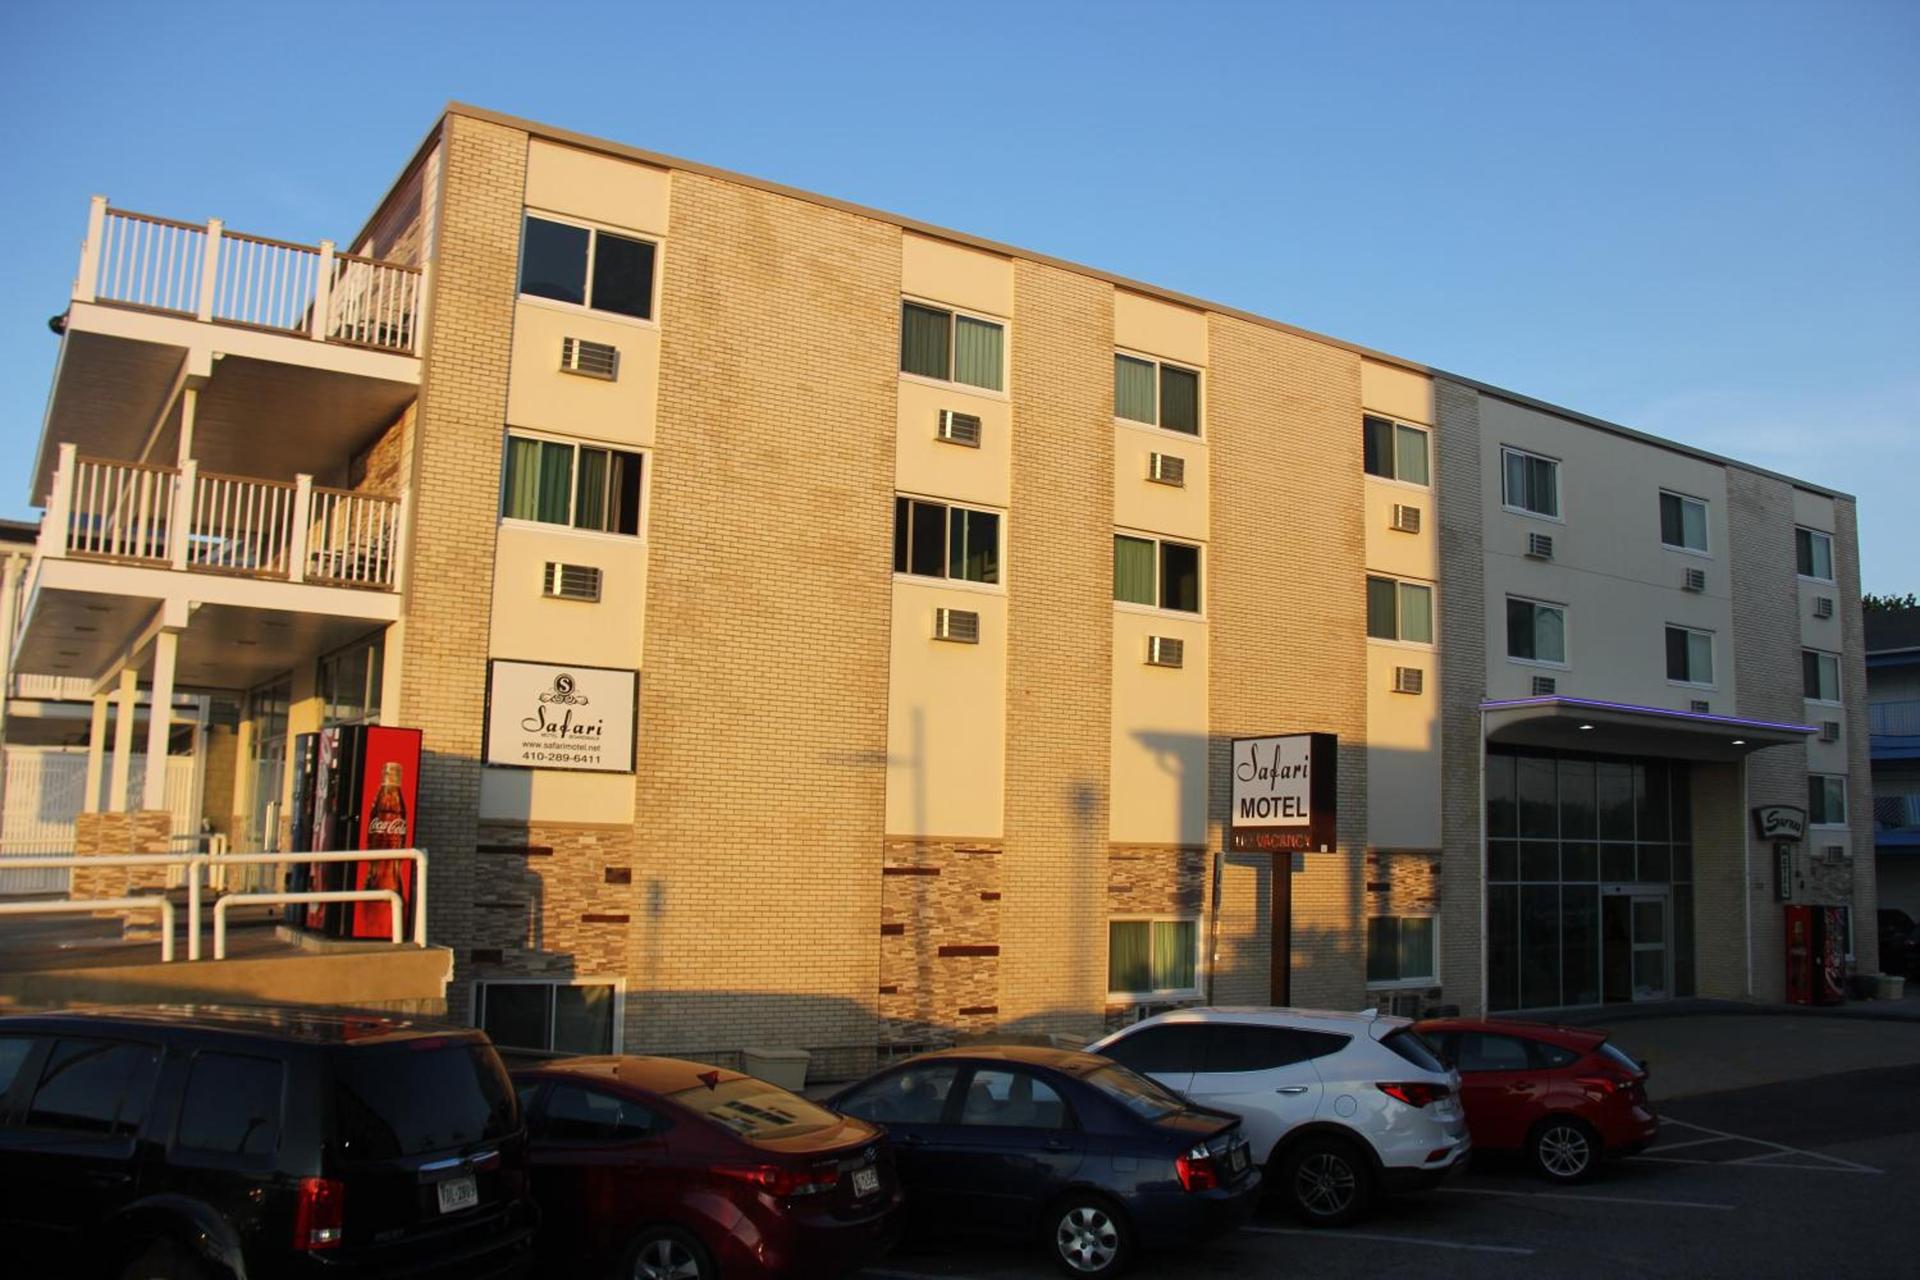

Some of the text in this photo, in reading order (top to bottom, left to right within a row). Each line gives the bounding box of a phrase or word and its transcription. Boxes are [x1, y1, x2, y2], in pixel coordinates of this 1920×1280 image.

[521, 704, 603, 739] Safari
[522, 740, 602, 752] www.safarimotel.net
[522, 751, 601, 764] 410-289-6411
[1236, 743, 1309, 791] Safari
[1240, 796, 1308, 818] MOTEL
